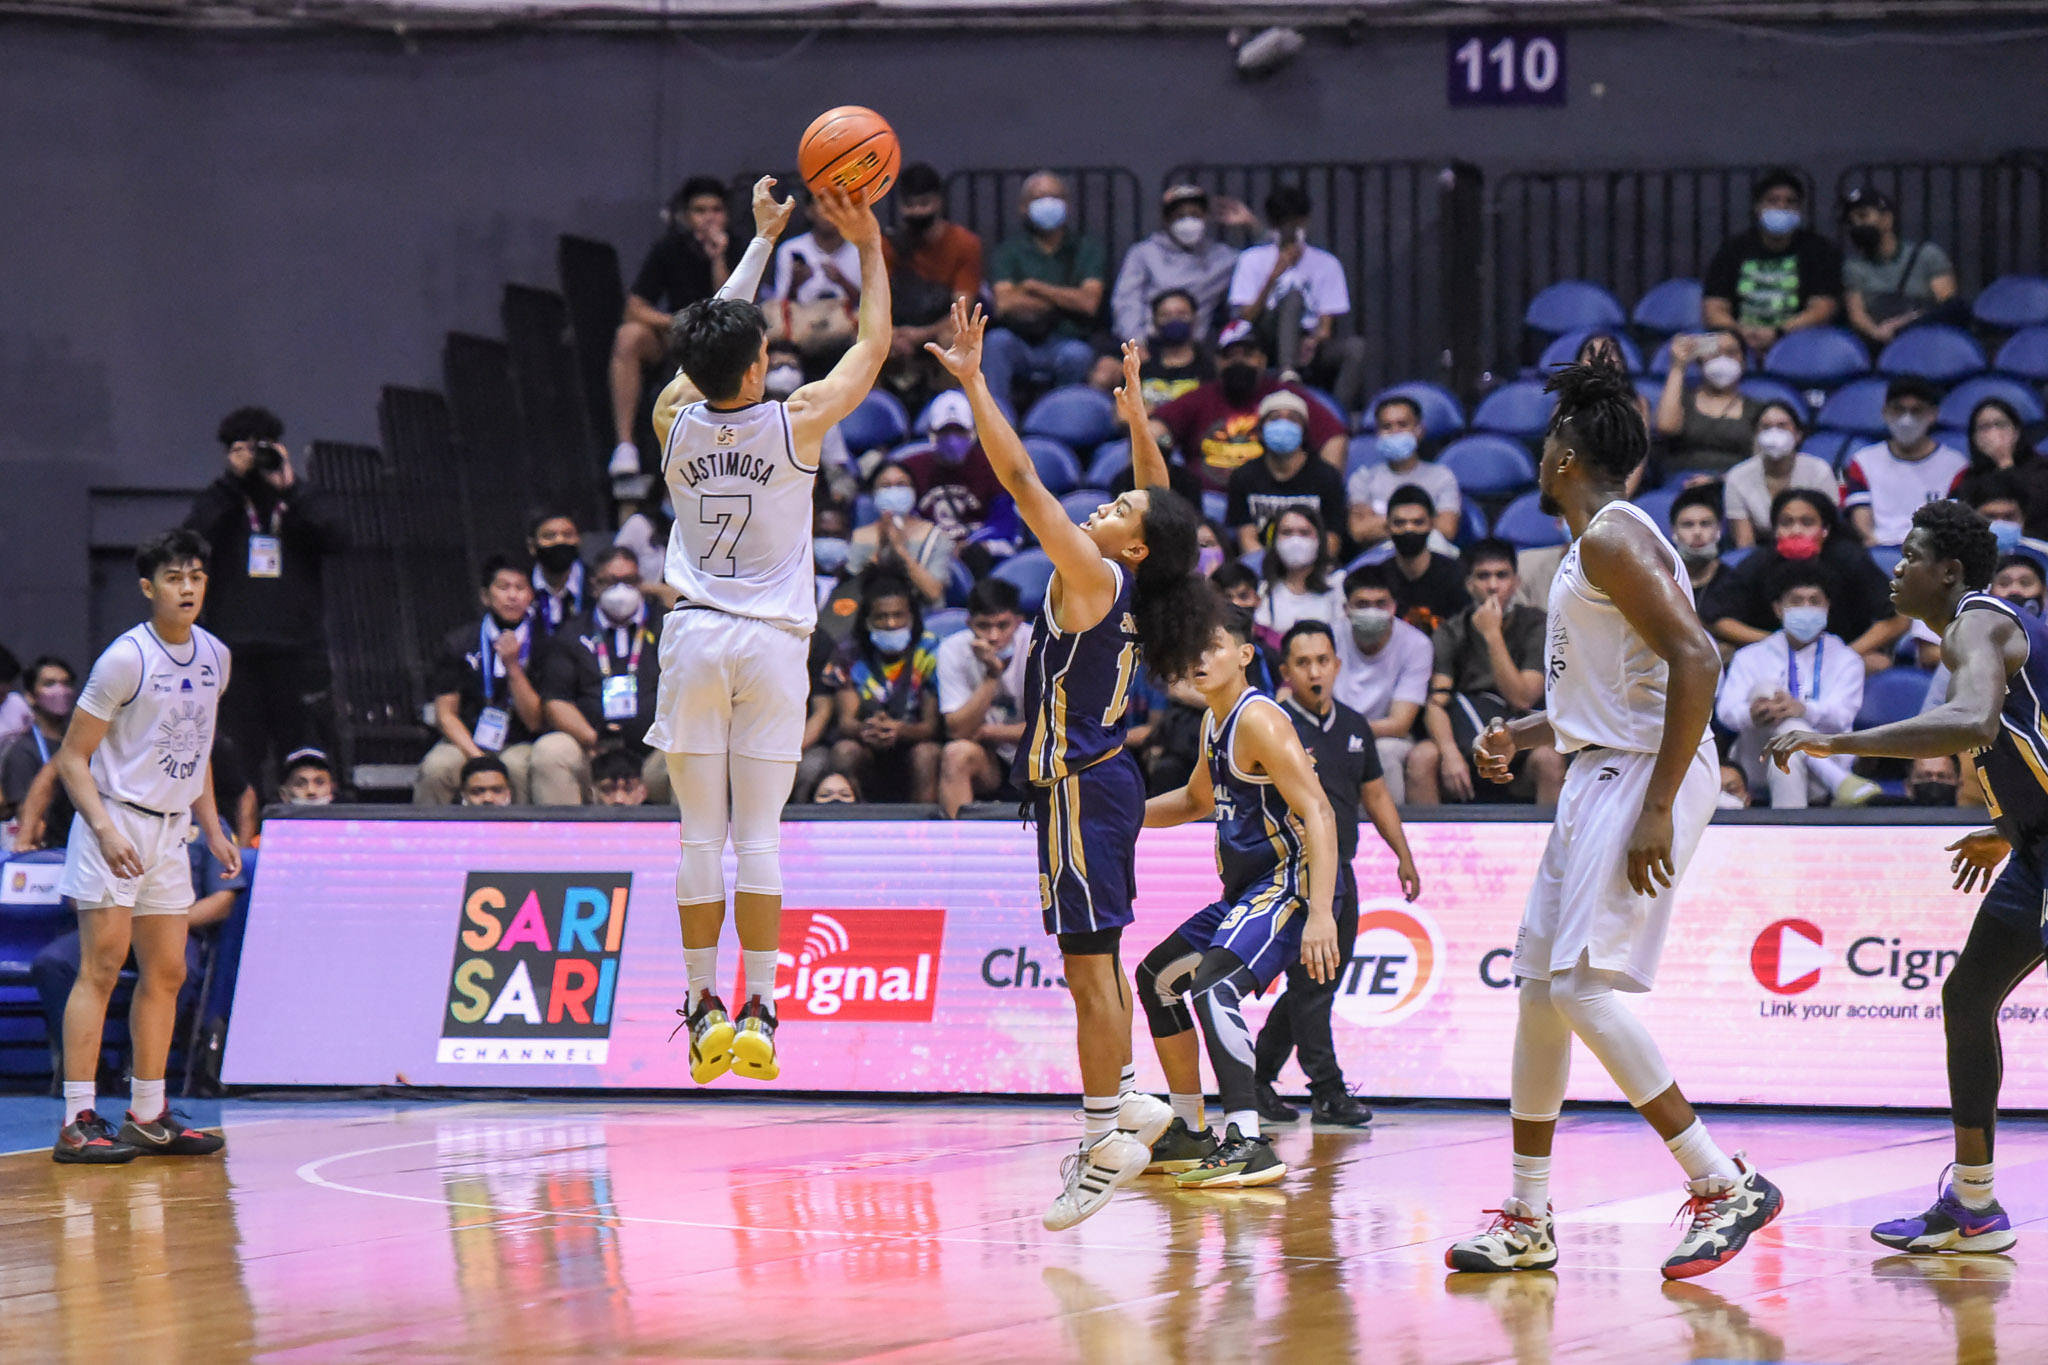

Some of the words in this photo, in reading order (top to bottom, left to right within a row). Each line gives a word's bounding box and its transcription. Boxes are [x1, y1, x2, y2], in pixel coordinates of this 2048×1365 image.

[1456, 36, 1559, 92] 110
[679, 451, 775, 488] LASTIMOSA
[700, 494, 752, 577] 7
[461, 886, 628, 952] SARI
[1846, 936, 1960, 991] Cign
[450, 958, 618, 1025] SARI
[1759, 1001, 1797, 1018] Link
[1803, 1004, 1840, 1020] your
[1846, 1003, 1919, 1019] account
[1924, 1004, 1941, 1019] at
[453, 1047, 592, 1061] CHANNEL
